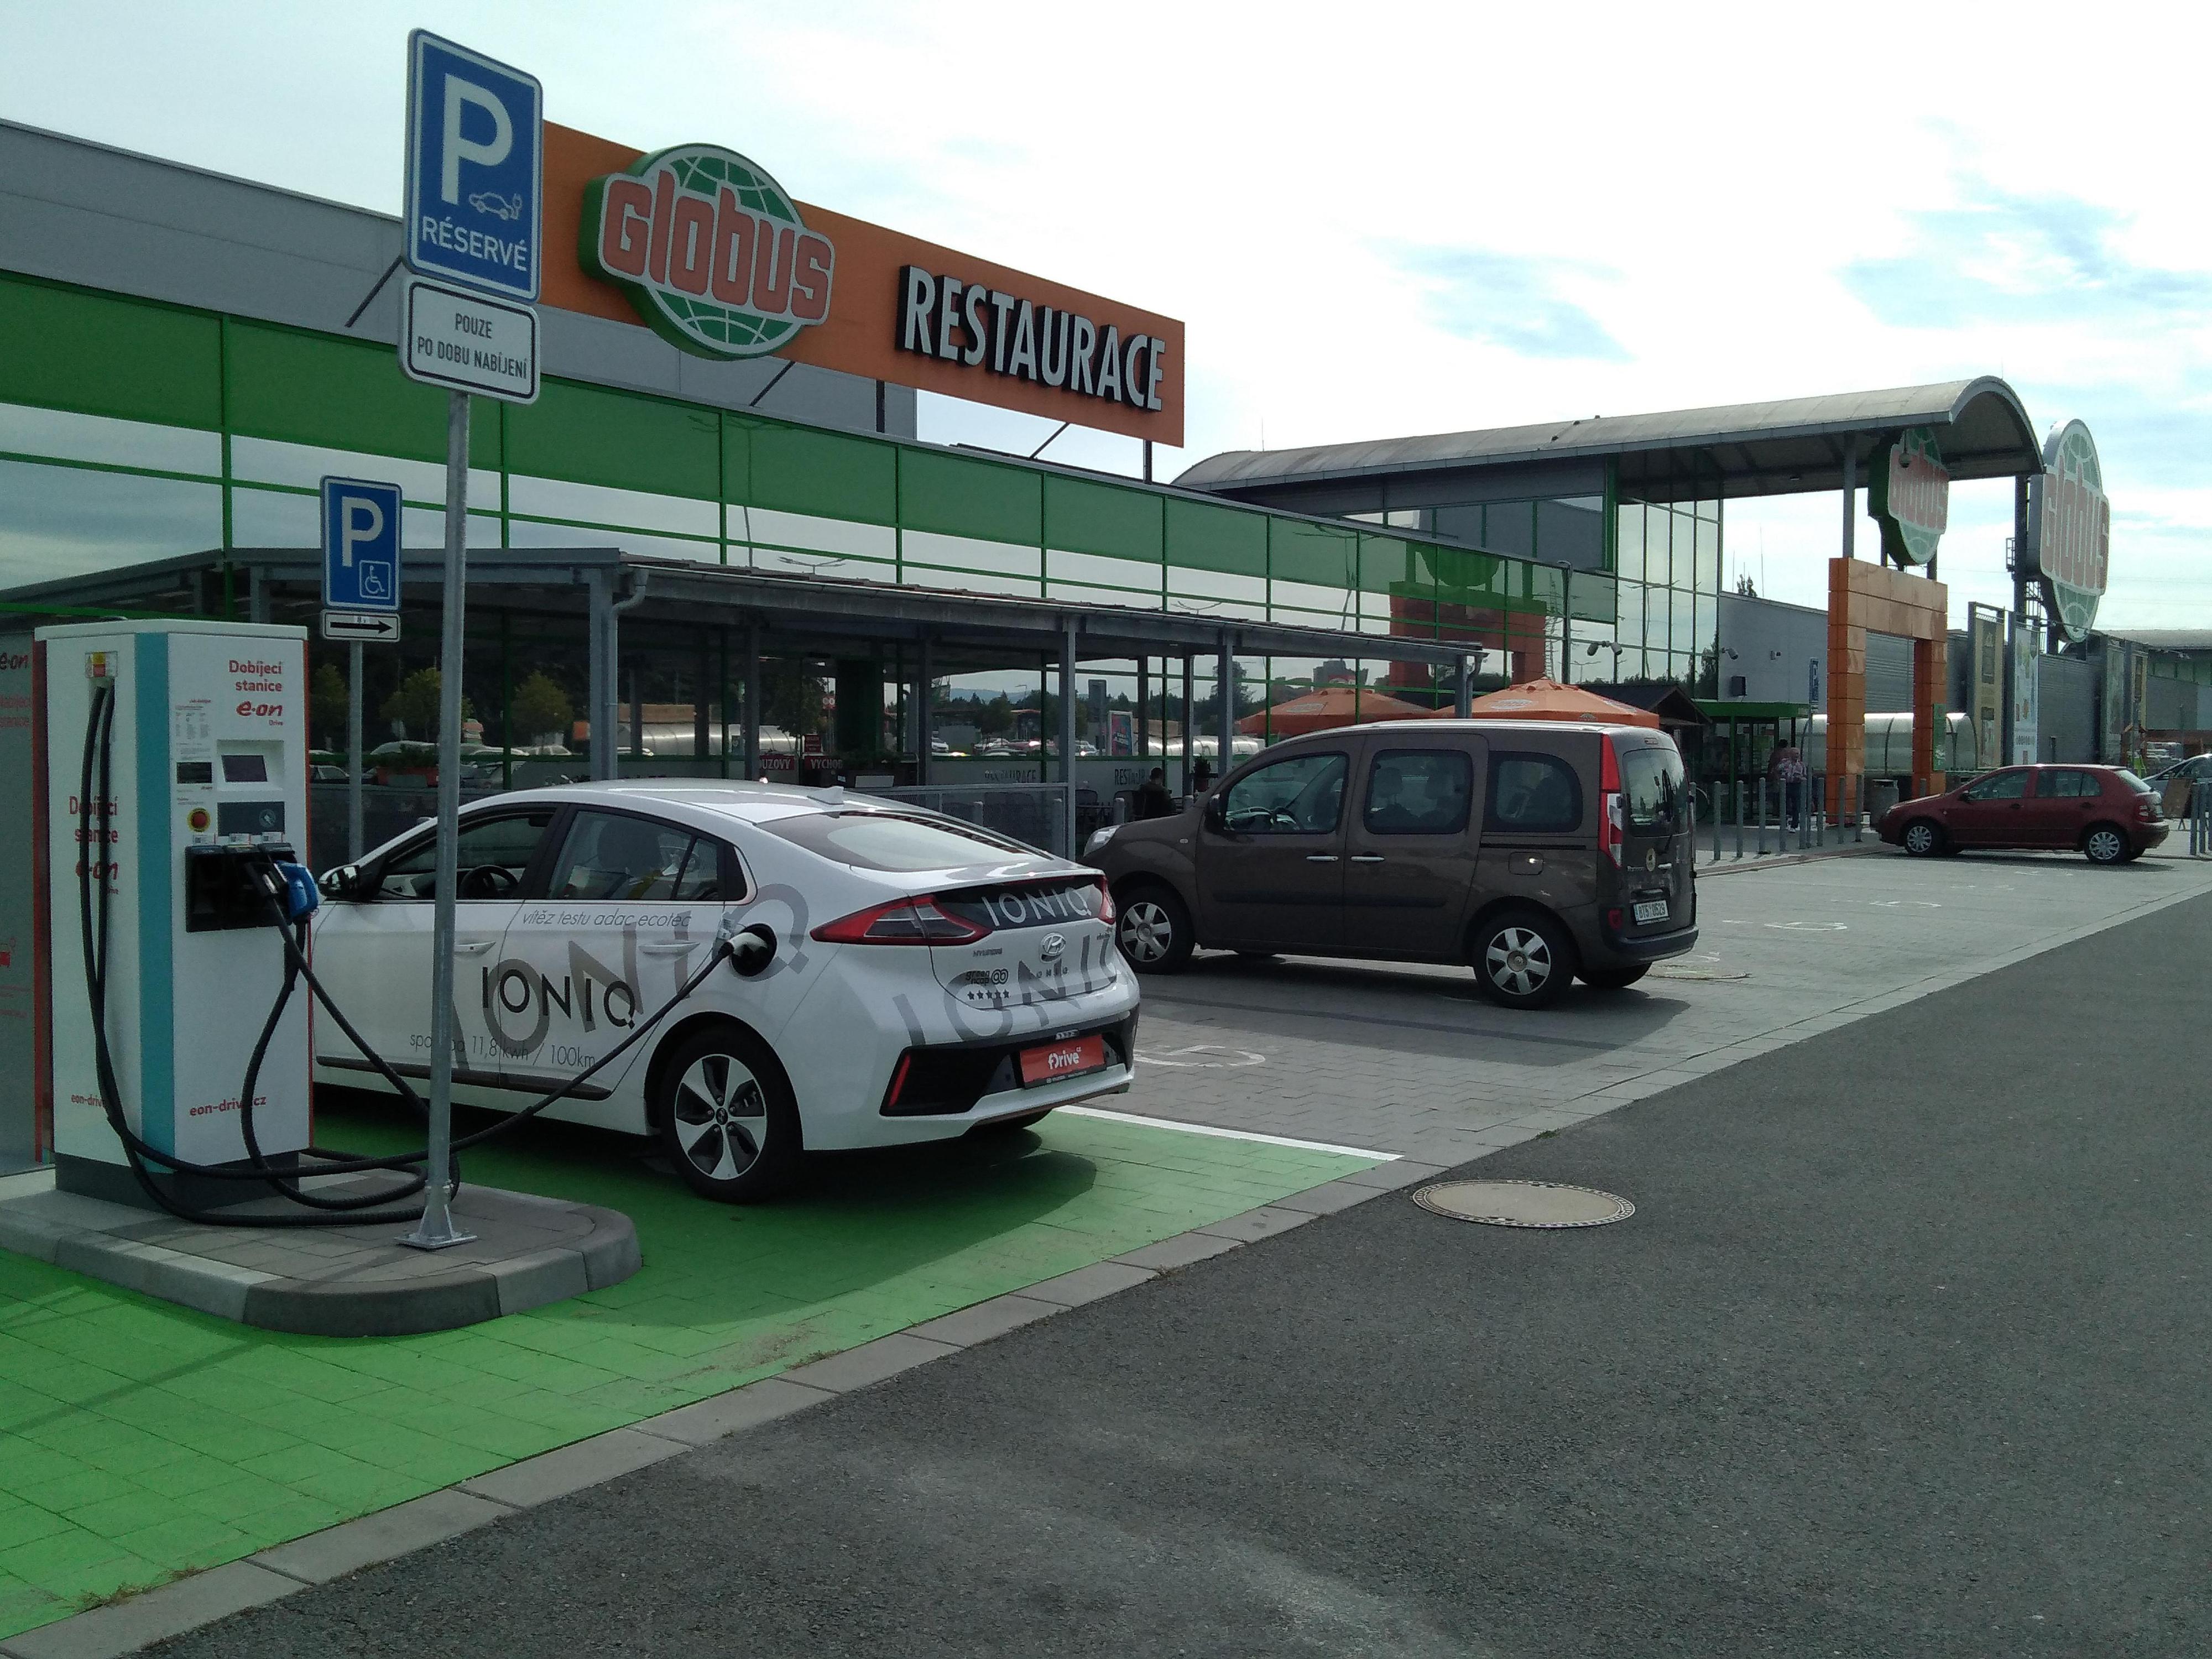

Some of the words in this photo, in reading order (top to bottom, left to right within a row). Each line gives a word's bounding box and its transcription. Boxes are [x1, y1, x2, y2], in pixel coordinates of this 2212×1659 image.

[441, 73, 513, 205] P
[422, 216, 528, 272] RÉSERVÉ
[603, 170, 832, 319] Globus
[455, 313, 493, 339] POUZE
[897, 264, 1166, 411] RESTAURACE
[417, 336, 433, 356] PO
[437, 341, 469, 366] DOBU
[474, 351, 527, 379] NABÍJENÍ
[342, 496, 383, 567] P
[236, 679, 283, 692] stanice
[523, 909, 555, 925] vítěz
[557, 911, 591, 925] testu
[594, 907, 635, 926] adac
[982, 886, 1093, 927] IONIQ
[966, 970, 990, 980] green
[971, 977, 990, 985] ncap
[482, 967, 636, 1030] IONIQ
[472, 1035, 498, 1059] 11,8
[551, 1045, 595, 1068] 100km
[189, 1095, 267, 1116] eon-drivcz
